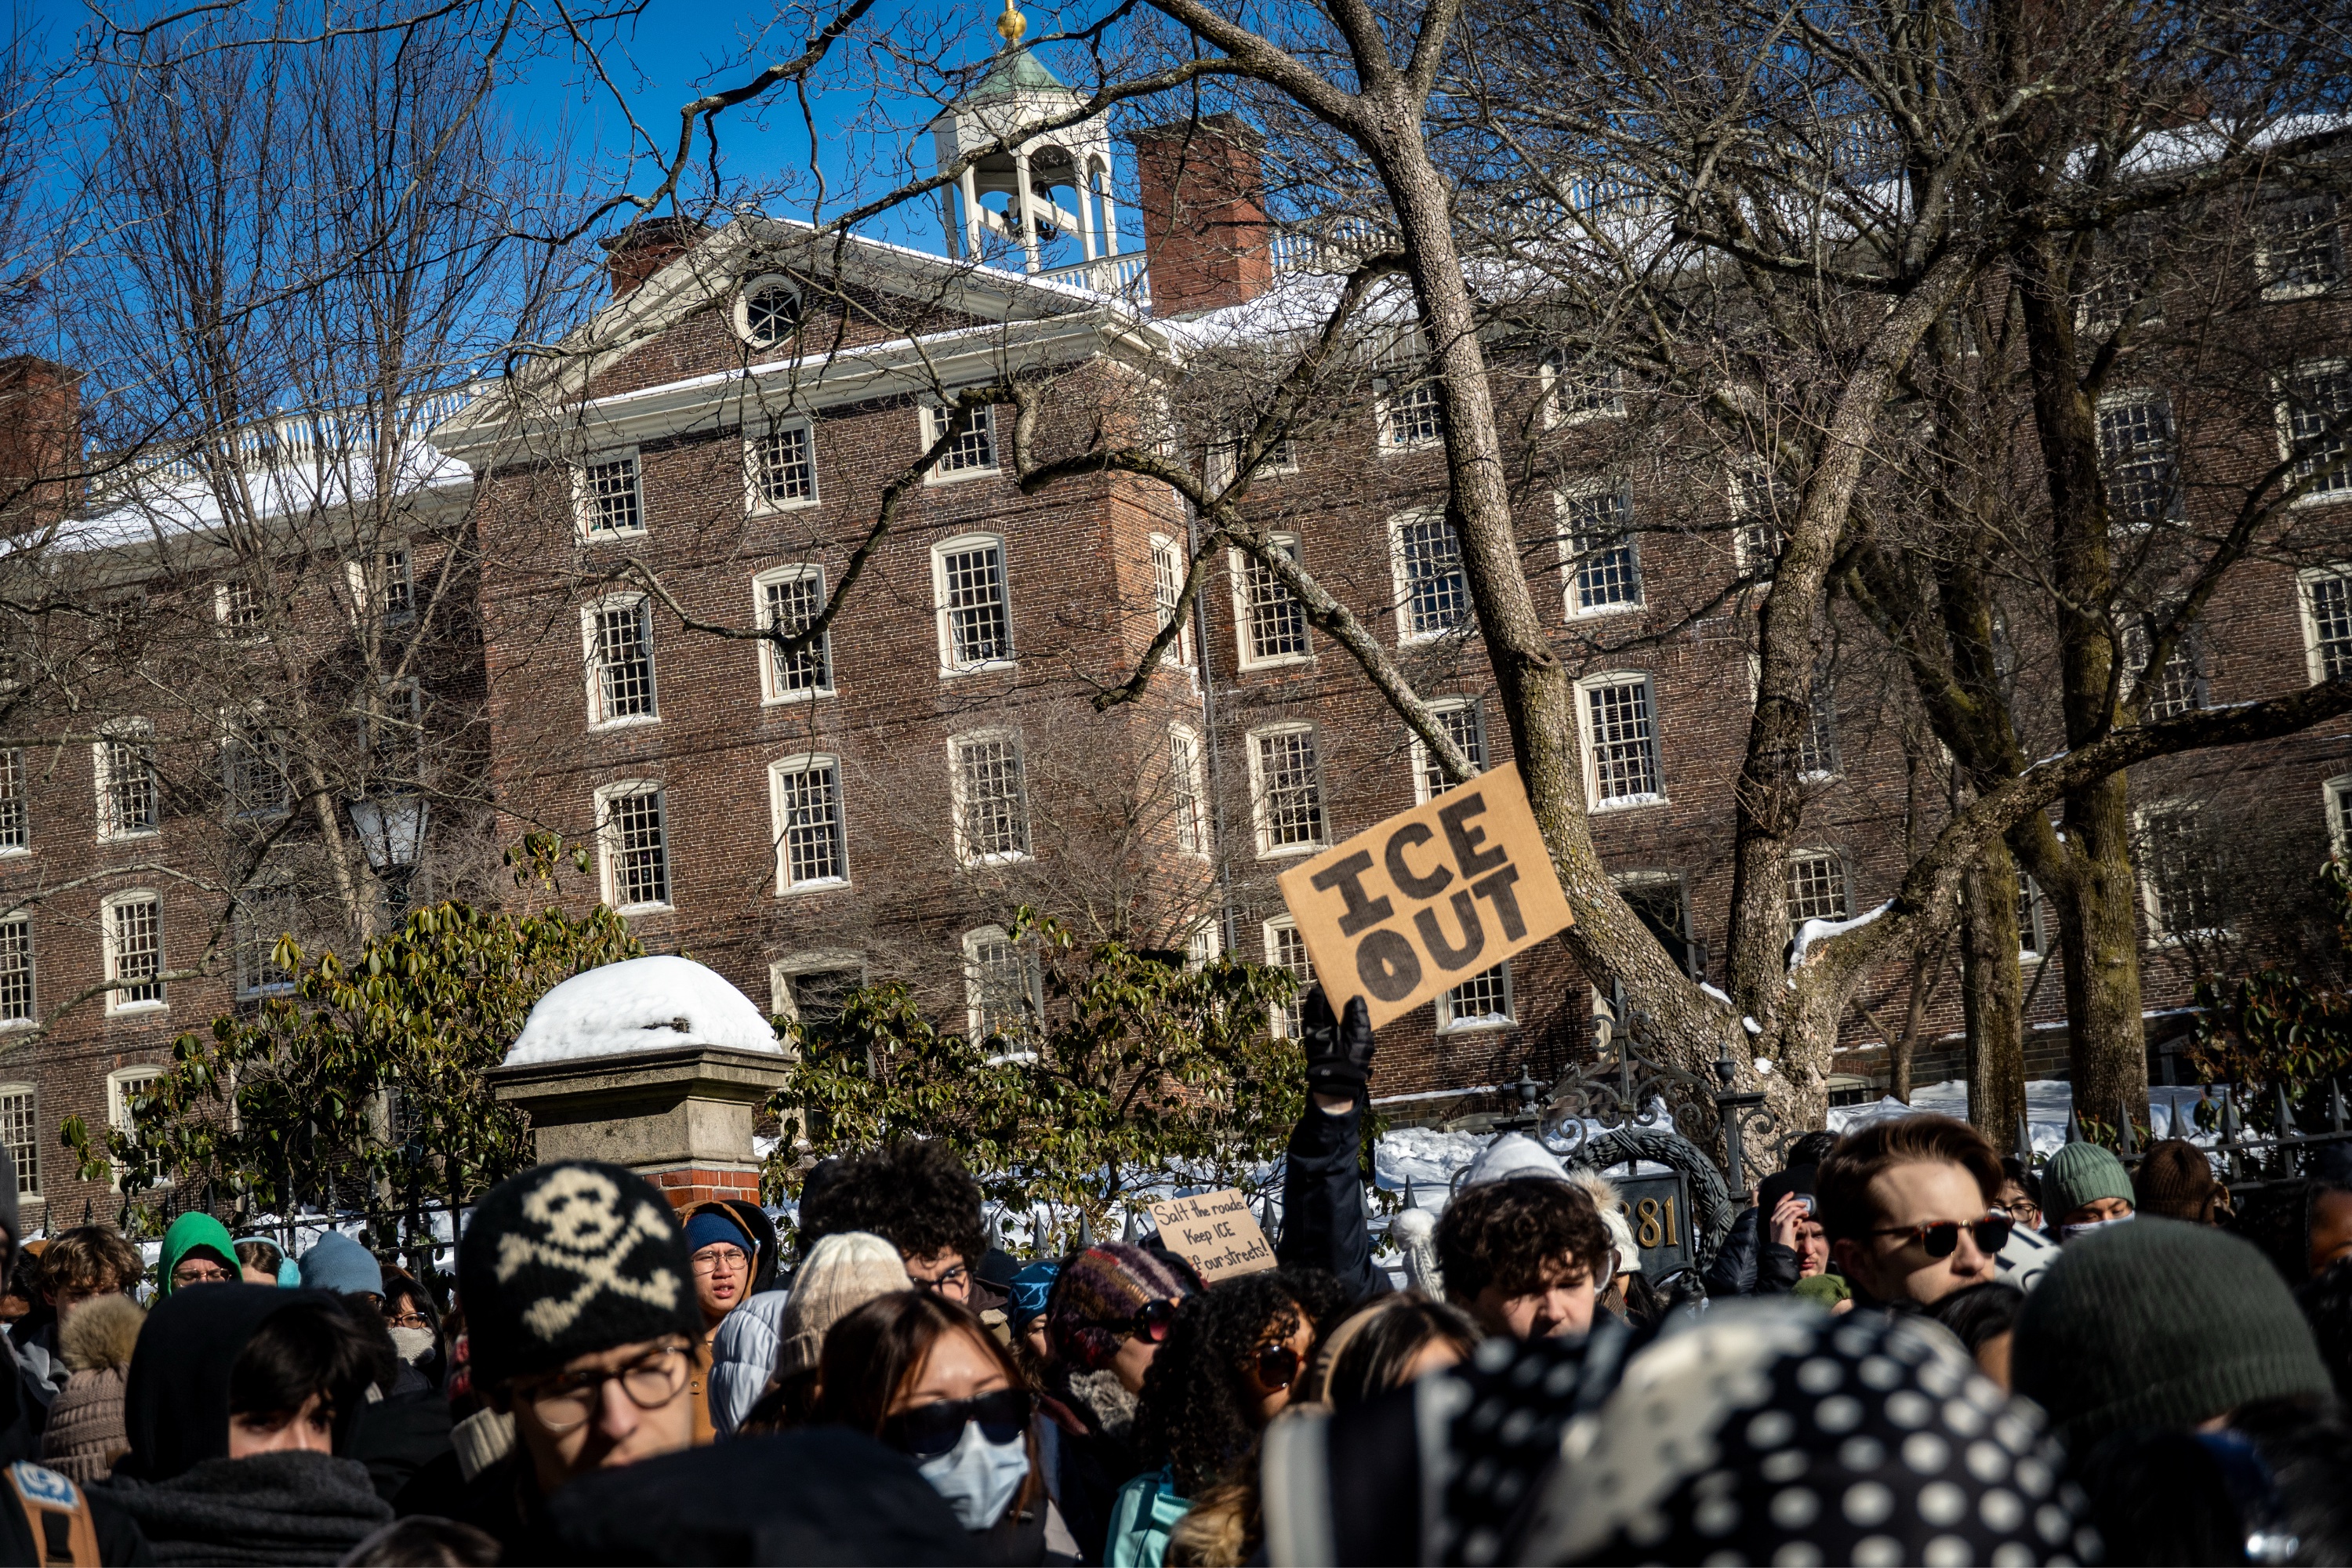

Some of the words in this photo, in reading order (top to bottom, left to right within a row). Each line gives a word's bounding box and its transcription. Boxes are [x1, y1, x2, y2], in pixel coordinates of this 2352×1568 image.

[1310, 792, 1508, 938] ICE
[1356, 862, 1528, 1003] OUT
[1154, 1203, 1189, 1225] Salt
[1189, 1199, 1210, 1218] the
[1211, 1194, 1247, 1214] roads.
[1620, 1196, 1678, 1247] 81
[1183, 1229, 1211, 1245] Keep
[1212, 1221, 1235, 1238] ICE
[1204, 1256, 1223, 1270] our
[1224, 1237, 1269, 1265] streets!
